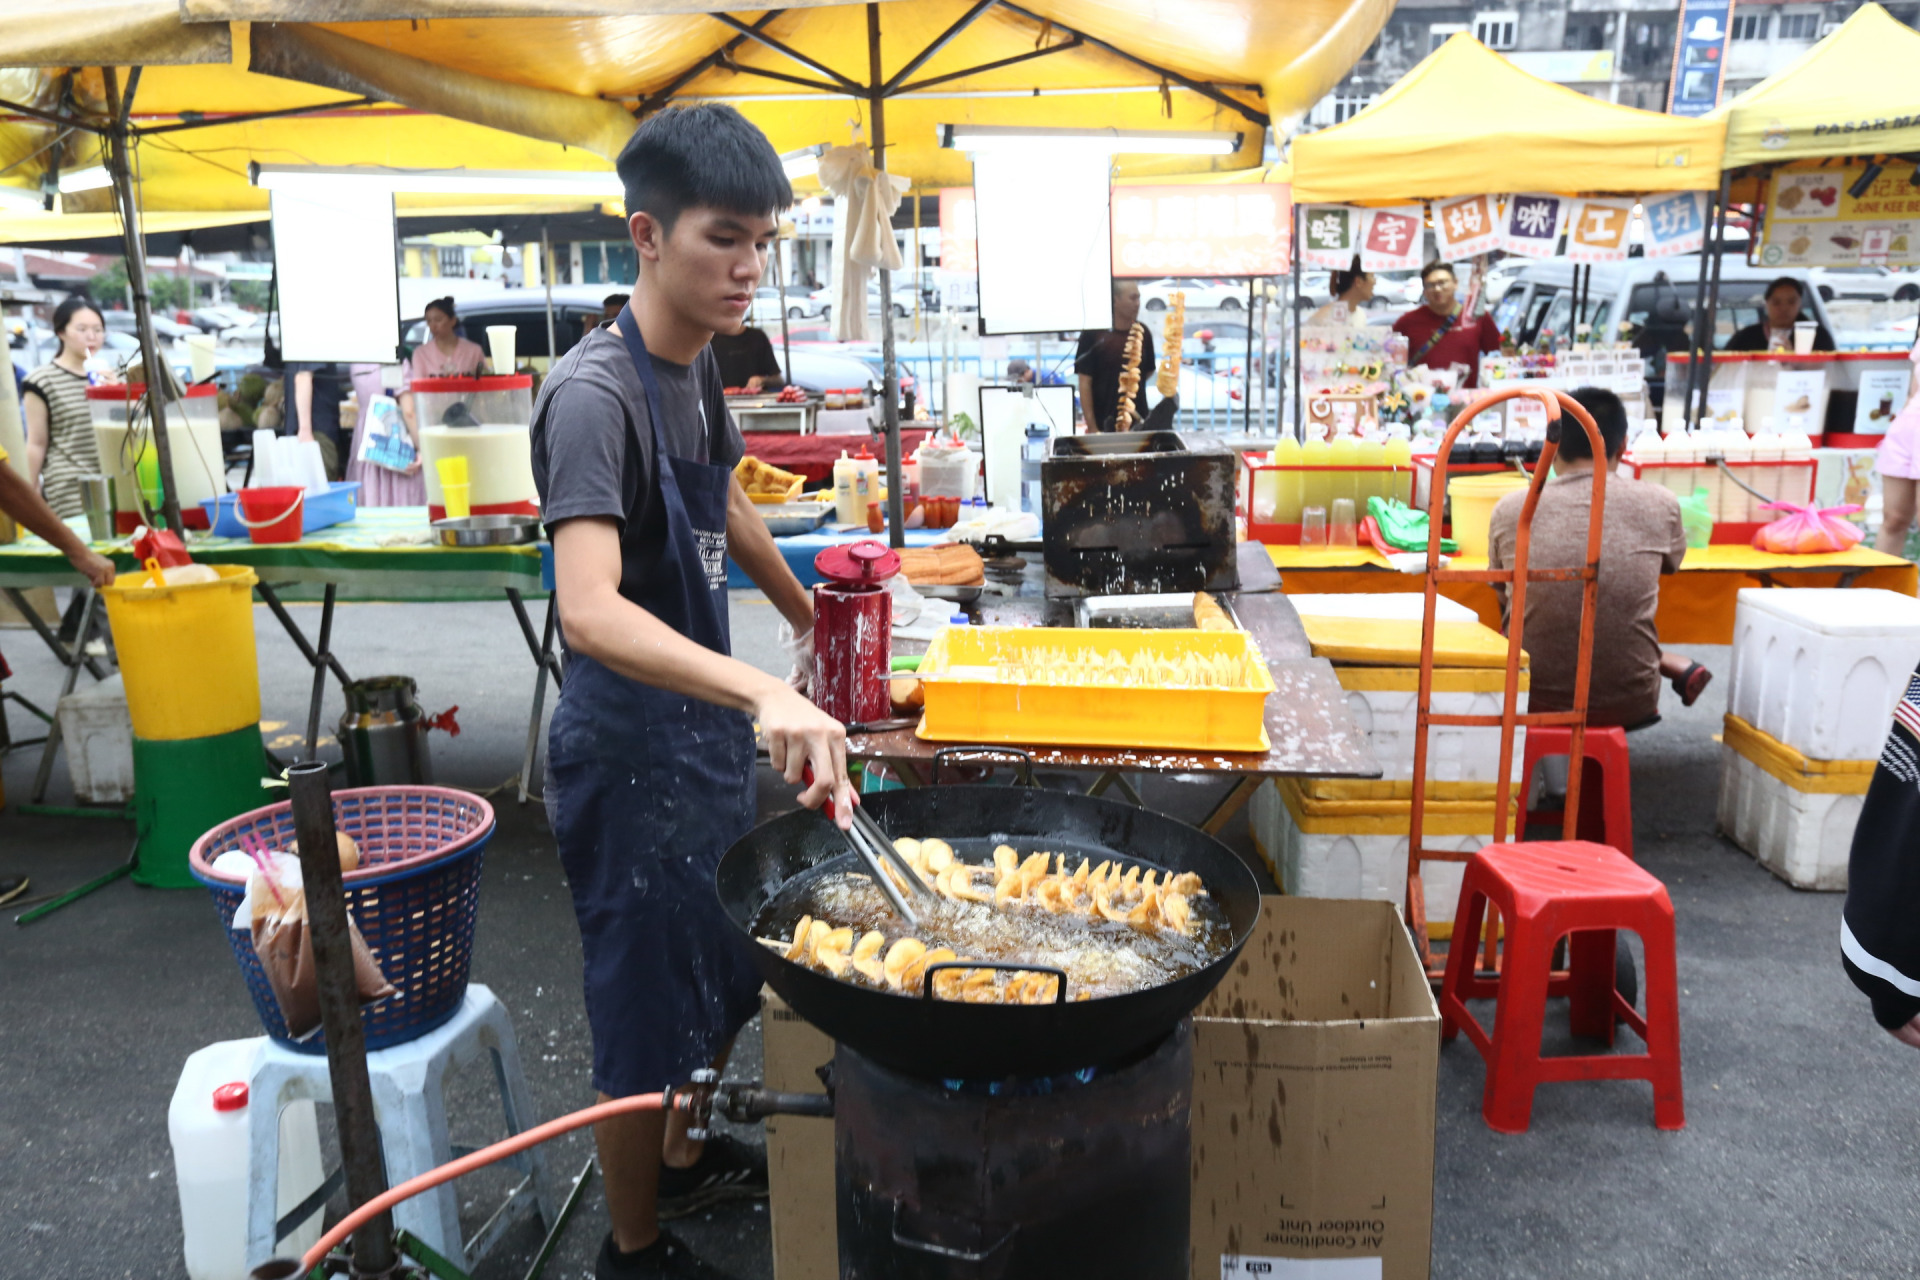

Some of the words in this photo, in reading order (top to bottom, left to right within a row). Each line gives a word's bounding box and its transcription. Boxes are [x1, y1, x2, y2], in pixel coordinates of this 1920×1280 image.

[1813, 117, 1887, 136] PASAR
[1883, 200, 1905, 213] KEE
[1279, 1219, 1312, 1233] Unit
[1318, 1219, 1385, 1234] Outdoor
[1263, 1232, 1357, 1249] Conditioner
[1361, 1235, 1383, 1249] Air
